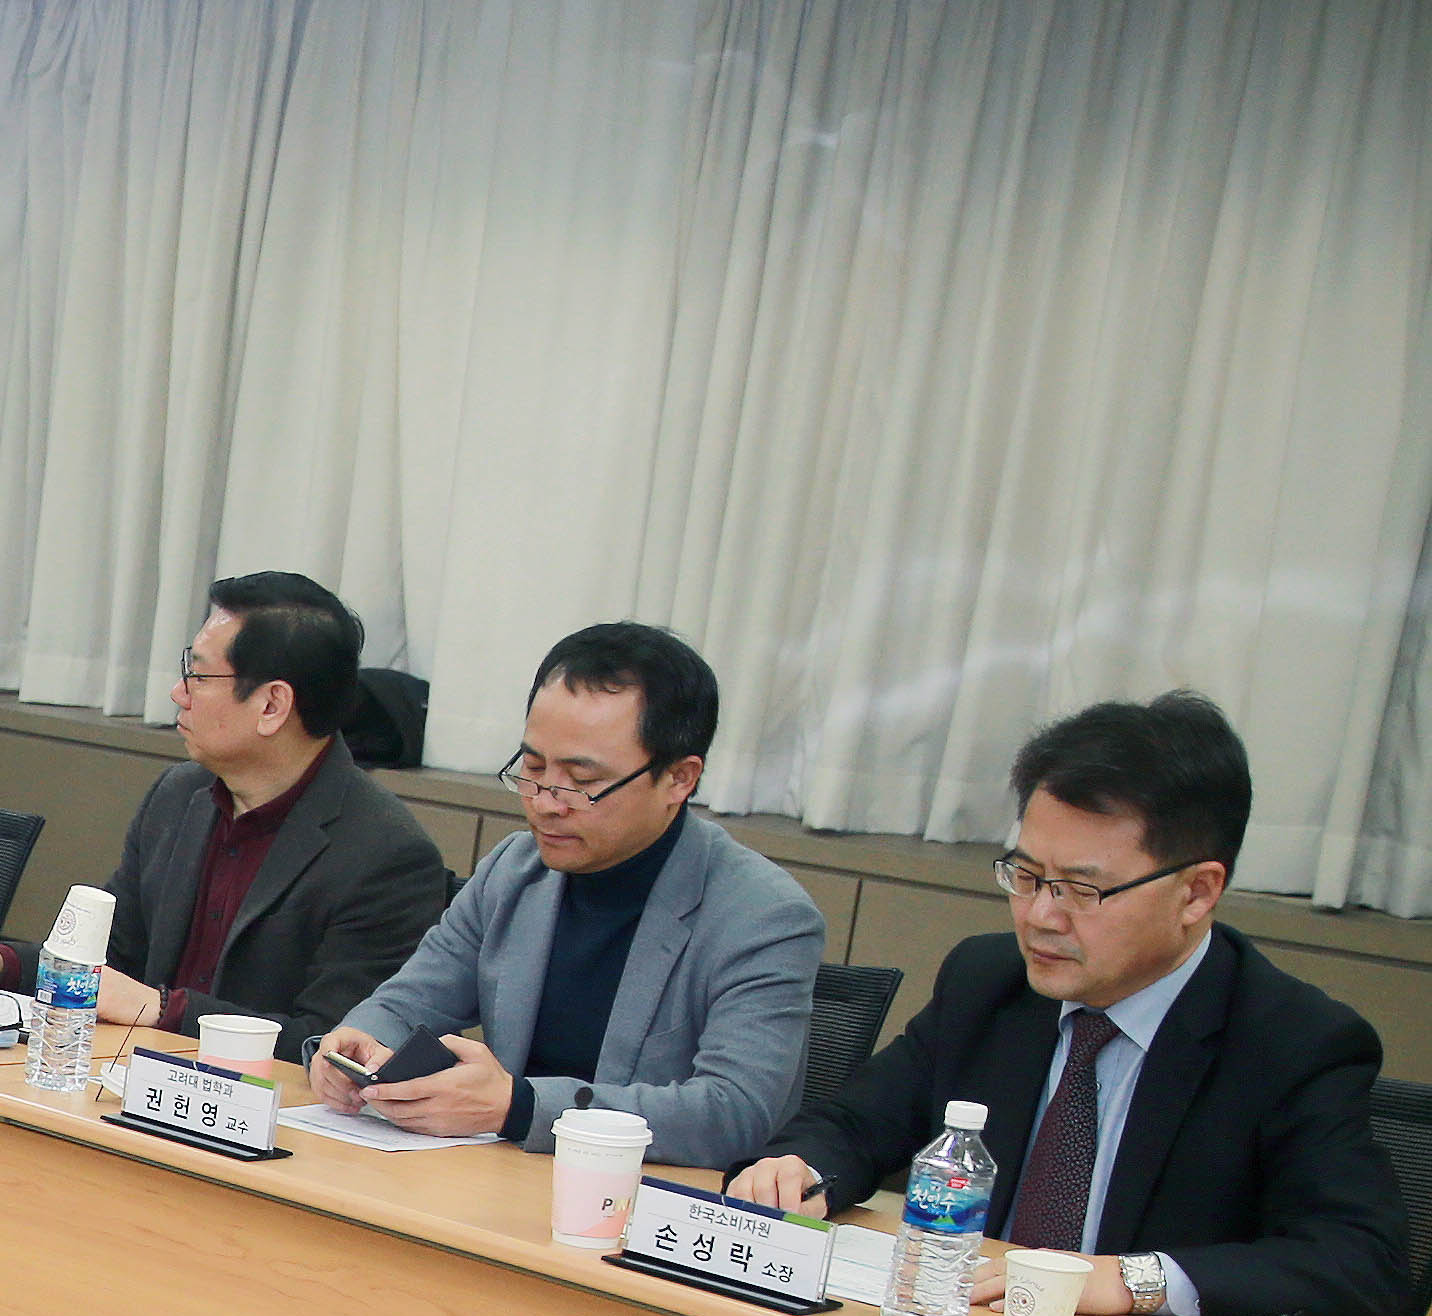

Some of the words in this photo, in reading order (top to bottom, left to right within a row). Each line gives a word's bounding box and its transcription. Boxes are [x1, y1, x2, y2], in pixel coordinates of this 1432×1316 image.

[167, 1069, 198, 1089] 고려대
[202, 1077, 233, 1099] 법학과
[225, 1116, 249, 1135] 교수
[688, 1202, 772, 1239] 한국소비자원
[761, 1261, 794, 1284] 소장
